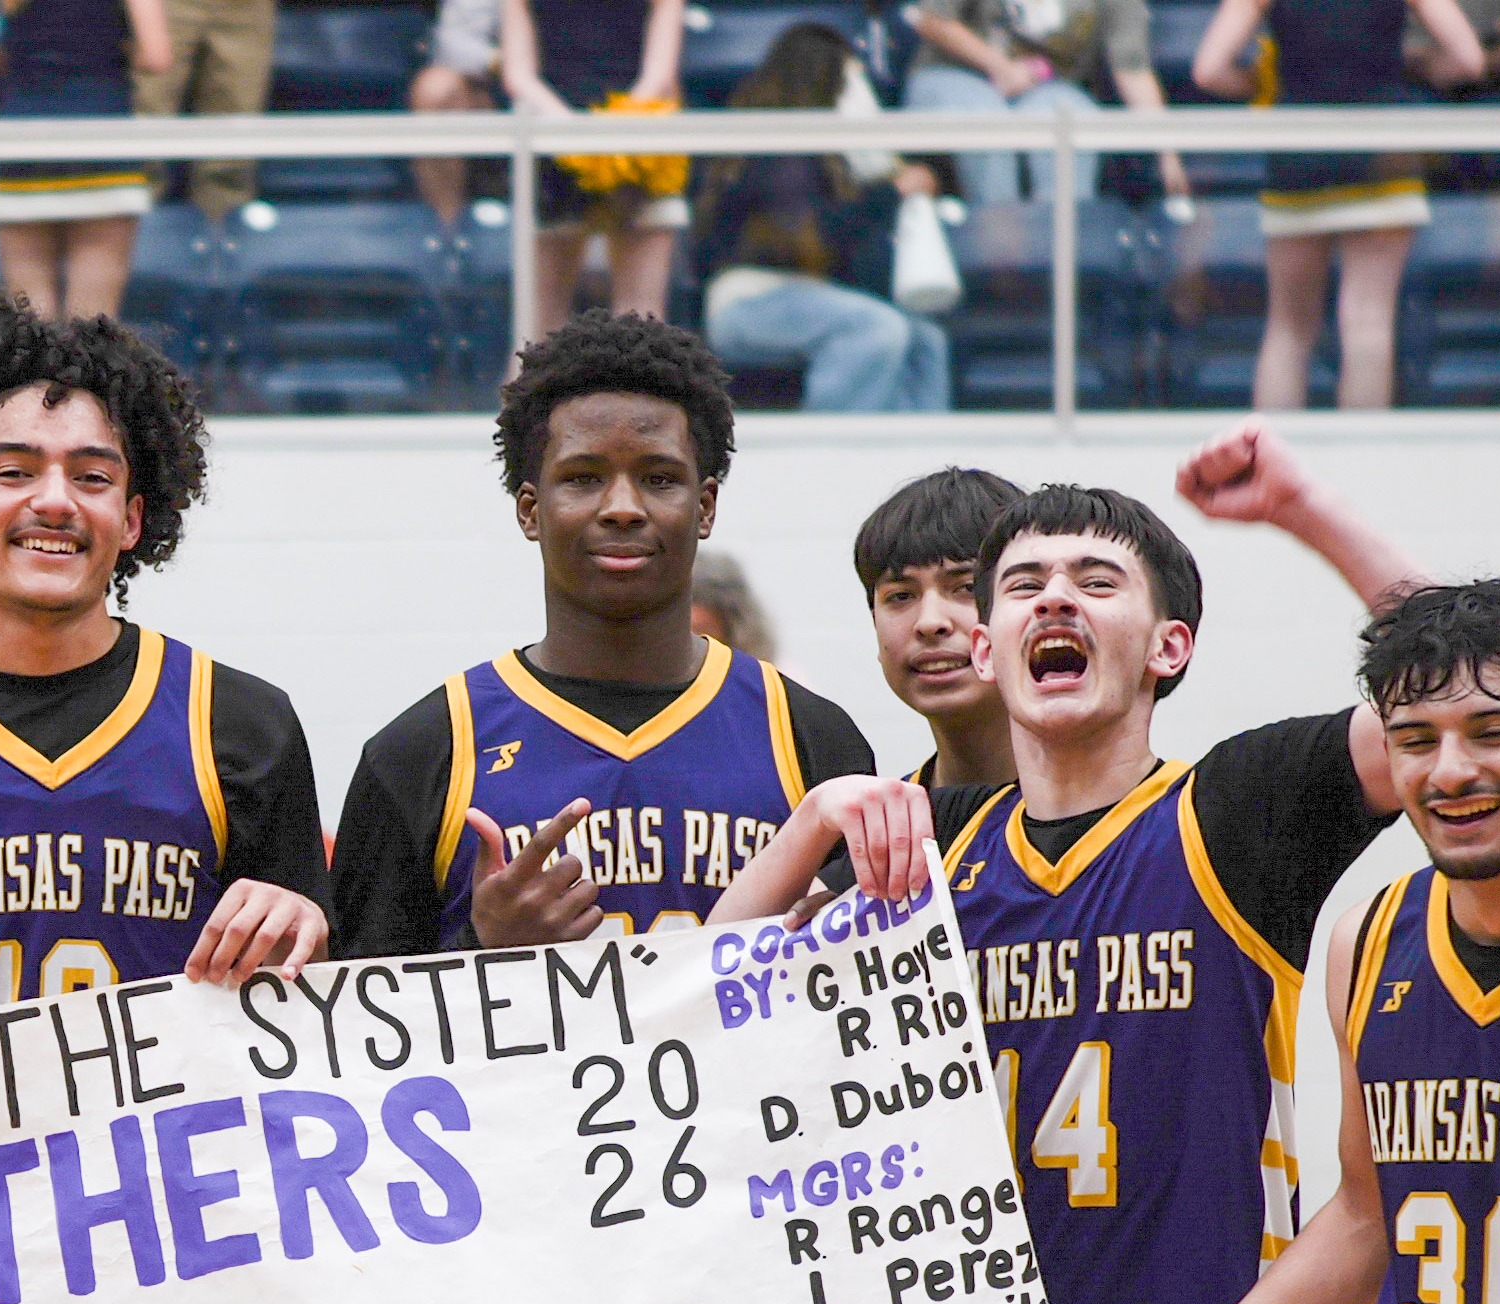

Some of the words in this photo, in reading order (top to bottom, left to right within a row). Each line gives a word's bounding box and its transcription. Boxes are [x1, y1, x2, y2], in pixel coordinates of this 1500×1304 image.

[101, 837, 201, 921] PASS
[715, 968, 795, 1029] BY:
[807, 963, 846, 1011] G.
[966, 939, 1079, 1024] ANSAS
[1095, 929, 1194, 1013] PASS
[837, 1007, 877, 1057] R.
[572, 1039, 700, 1136] 20
[761, 1095, 804, 1142] D.
[584, 1126, 708, 1228] 26
[747, 1142, 924, 1218] MGRS:
[785, 1219, 827, 1265] R.
[848, 1178, 1017, 1254] Range
